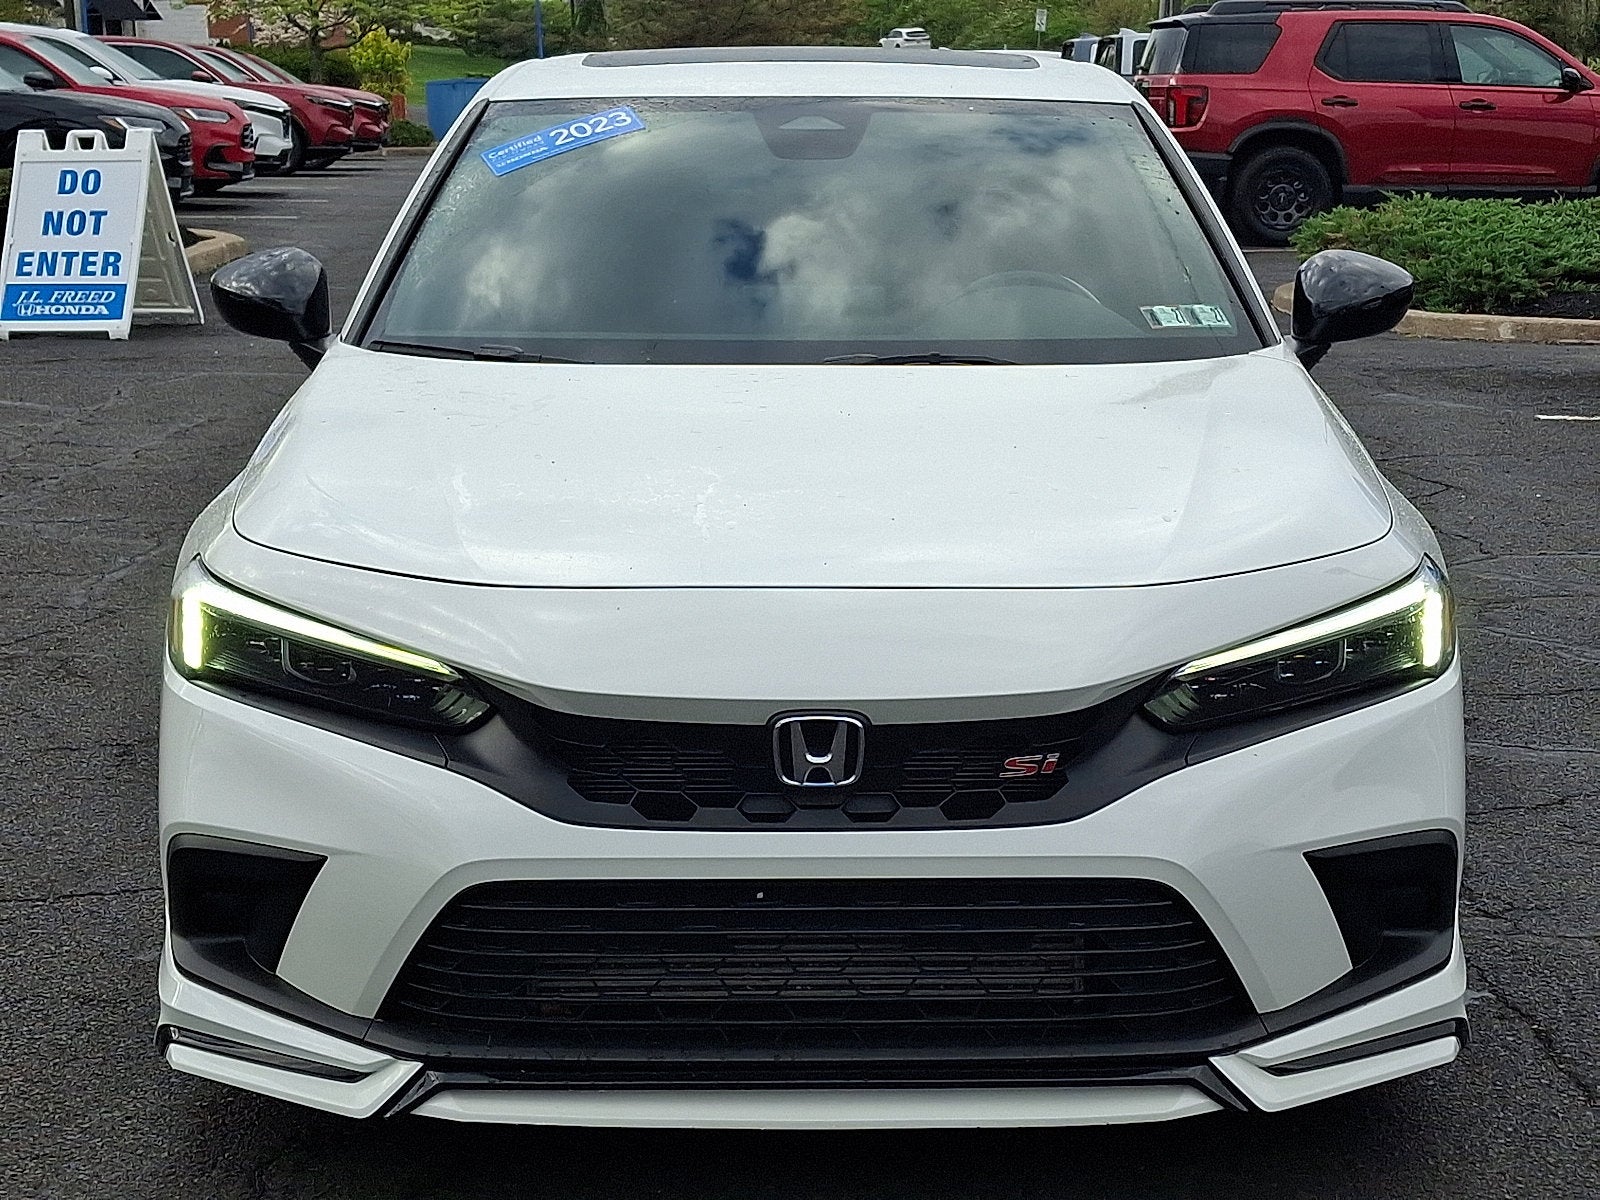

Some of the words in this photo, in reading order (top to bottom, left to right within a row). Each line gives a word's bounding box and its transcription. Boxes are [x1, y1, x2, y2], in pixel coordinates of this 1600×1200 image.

[549, 111, 632, 146] 2023
[488, 135, 542, 159] Certified
[57, 169, 102, 195] DO
[41, 210, 108, 236] NOT
[15, 251, 122, 277] ENTER
[12, 290, 43, 307] J.L.
[48, 290, 116, 304] FREED
[34, 304, 110, 315] HONDA
[999, 753, 1060, 777] Si
